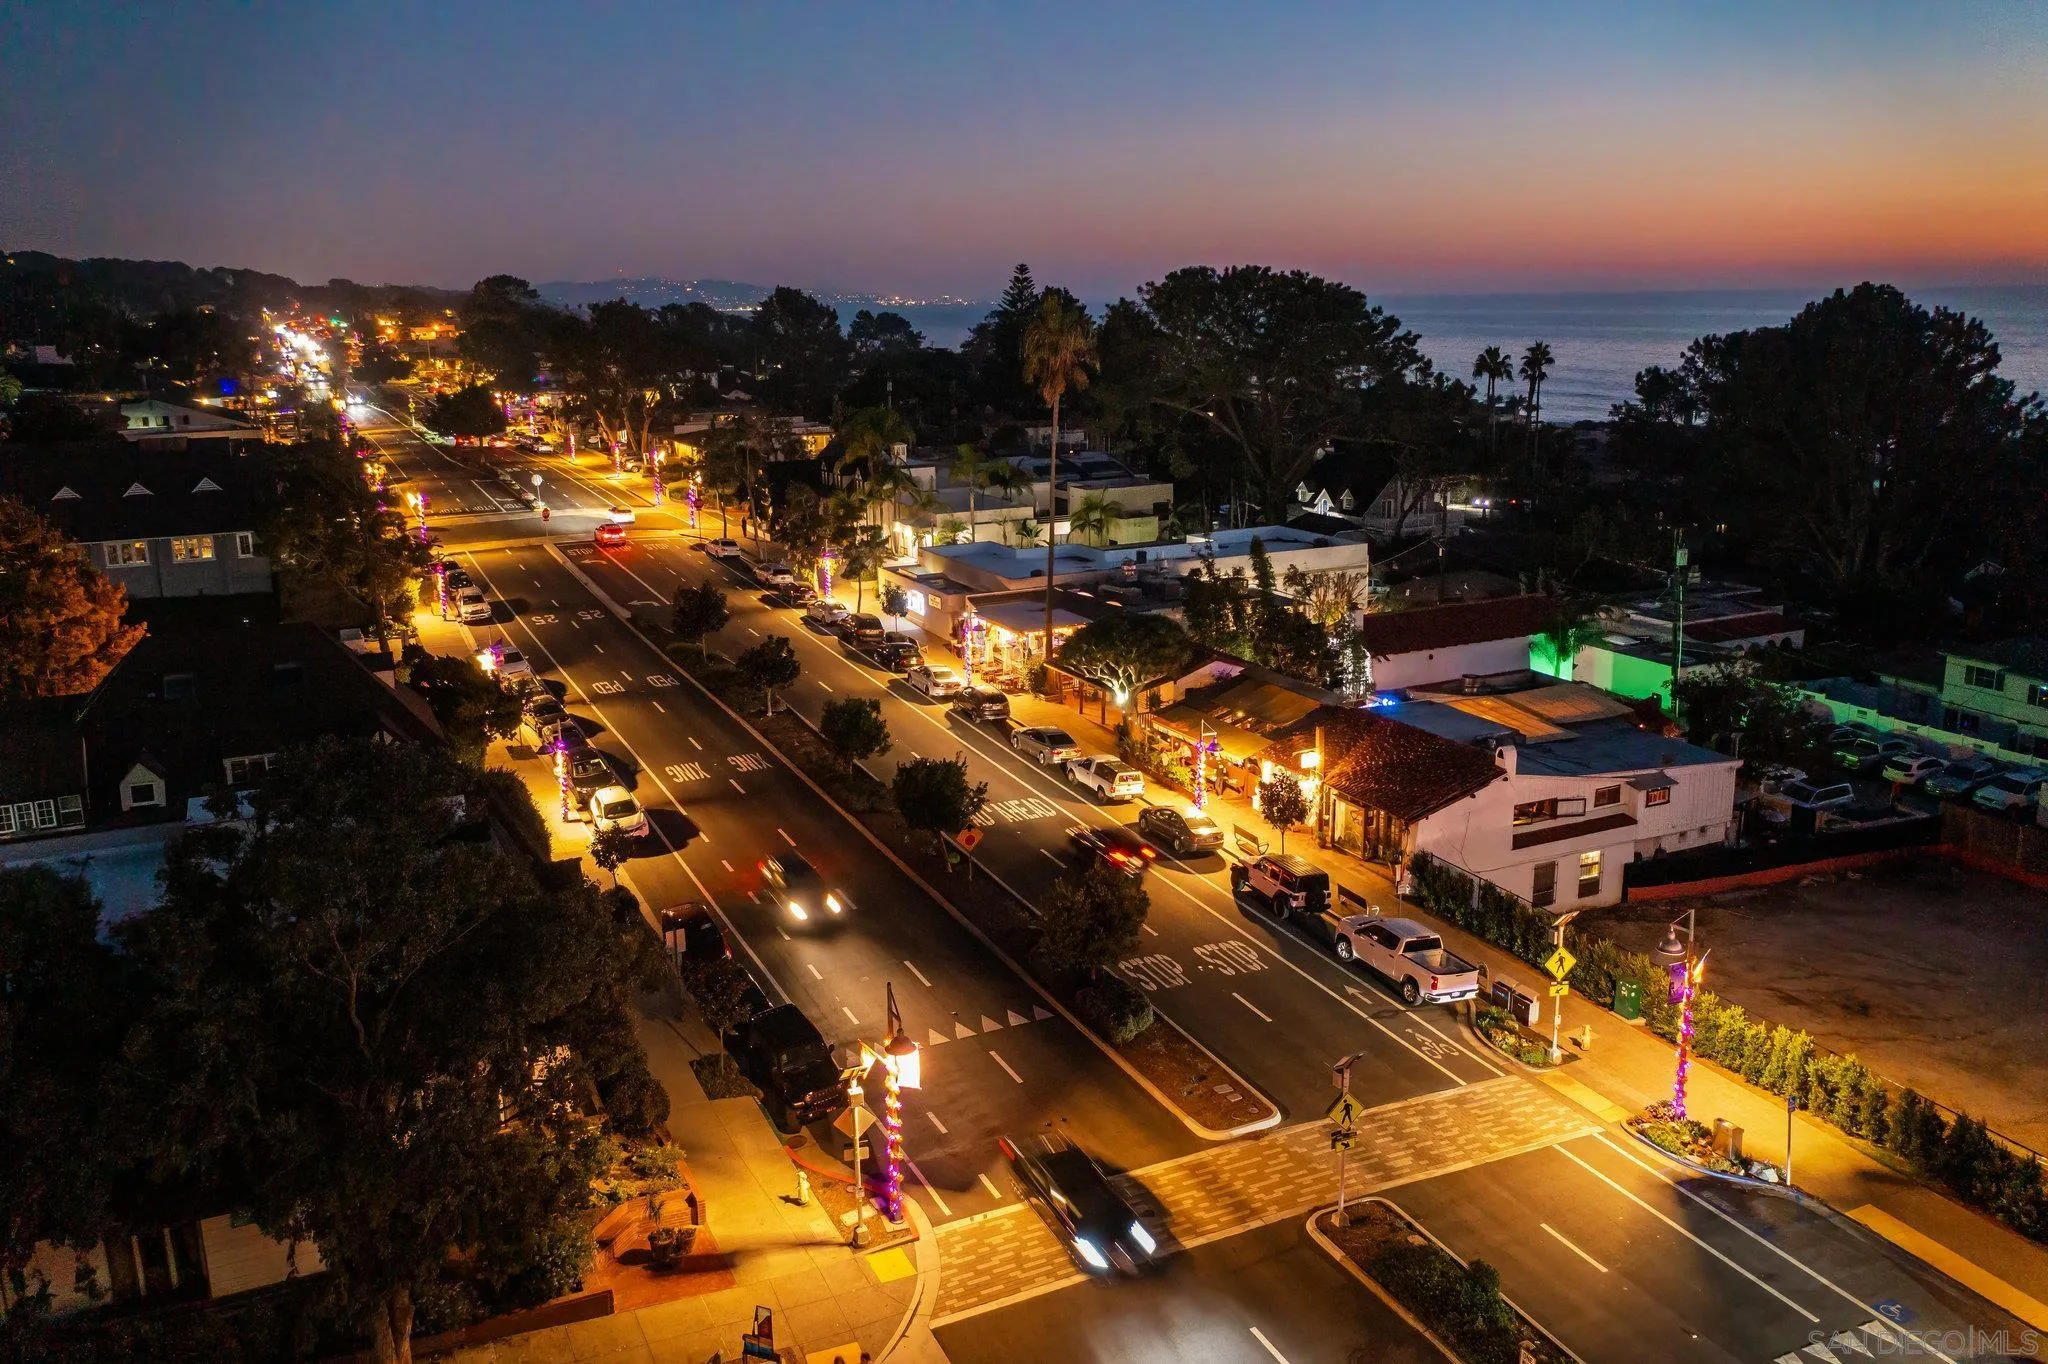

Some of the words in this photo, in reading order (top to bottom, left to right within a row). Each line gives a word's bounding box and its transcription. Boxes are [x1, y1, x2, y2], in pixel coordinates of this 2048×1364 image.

[531, 614, 559, 625] 25
[592, 680, 626, 695] PED
[646, 673, 680, 688] PED
[664, 761, 711, 783] XING
[727, 752, 772, 772] XING
[989, 797, 1057, 823] AHEAD
[1193, 940, 1269, 976] STOP
[1118, 953, 1192, 991] STOP
